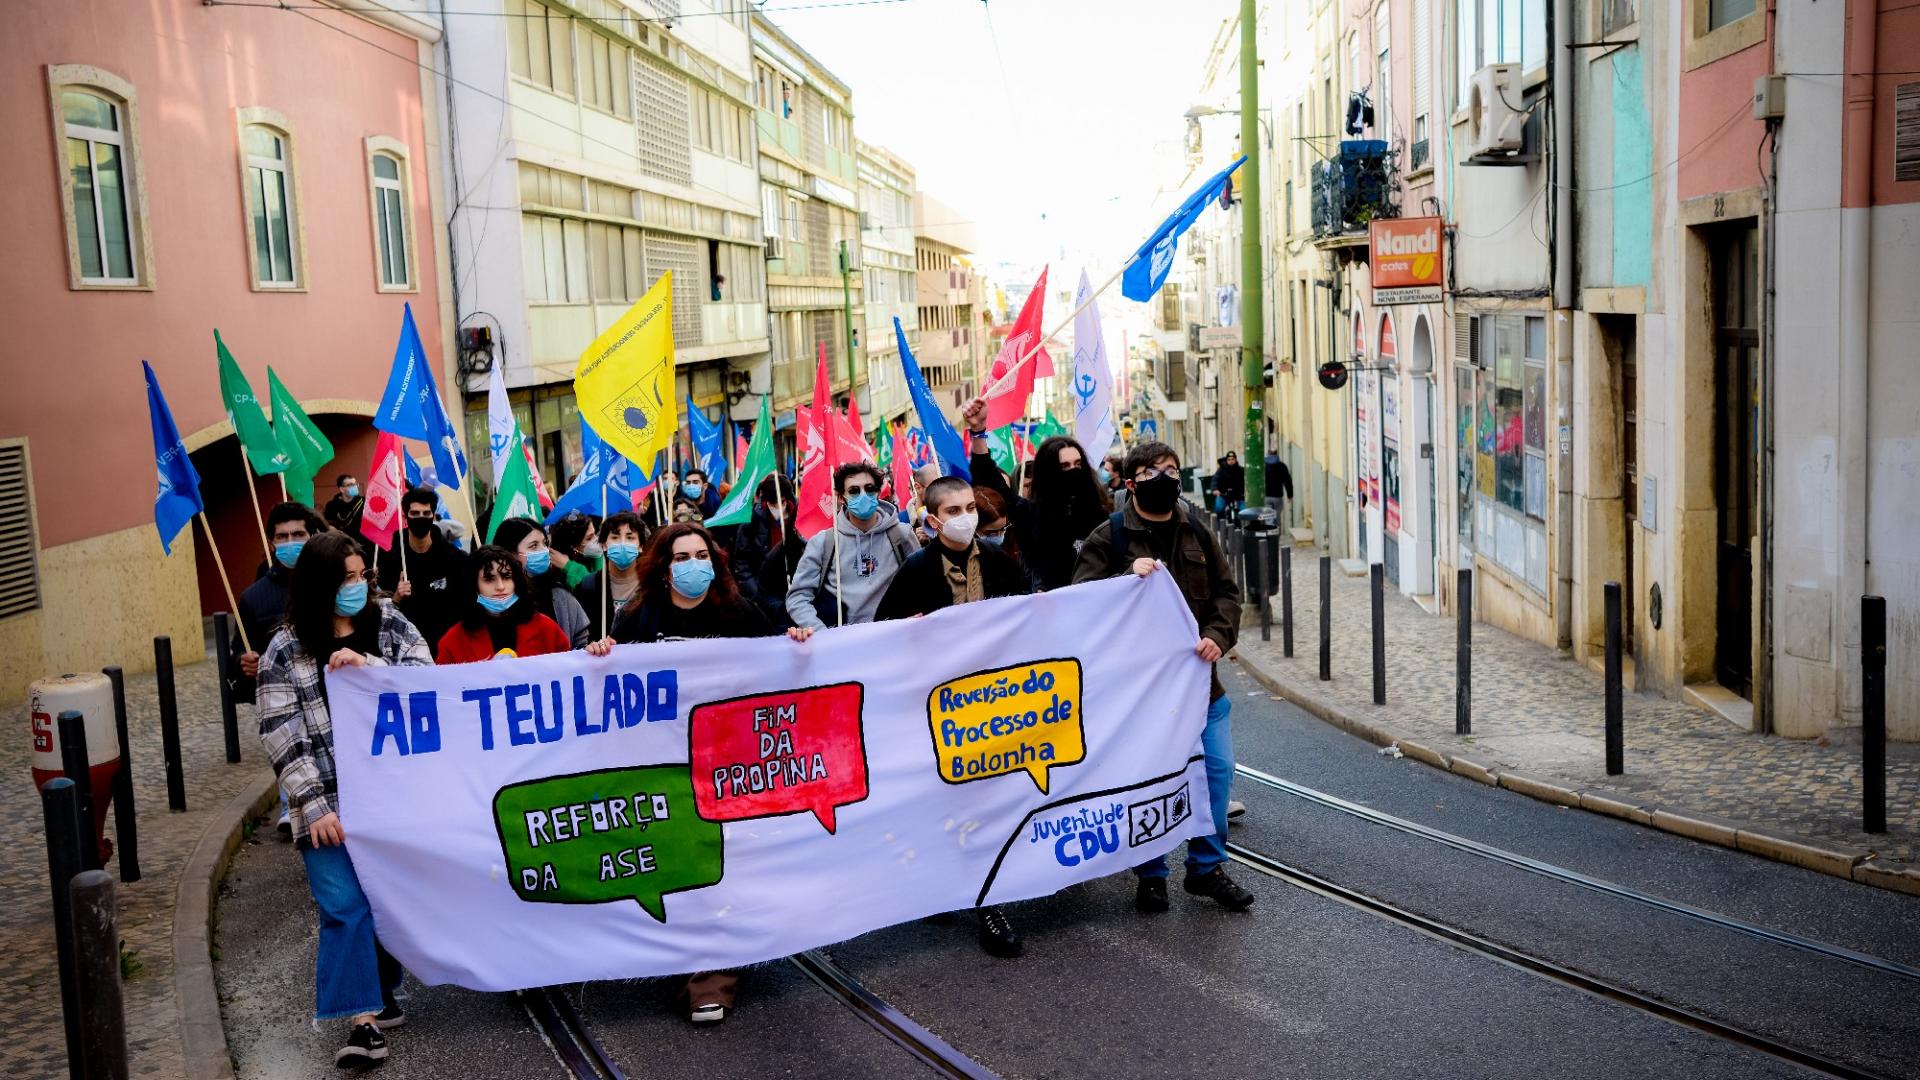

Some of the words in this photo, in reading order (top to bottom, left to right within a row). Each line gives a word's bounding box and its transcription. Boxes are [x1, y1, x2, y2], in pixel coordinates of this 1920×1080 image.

[1399, 293, 1440, 302] ESPERANÇA
[371, 691, 441, 756] AO
[462, 680, 563, 750] TEU
[573, 670, 677, 736] LADO
[939, 677, 1020, 713] Reversão
[1022, 669, 1055, 694] do
[941, 710, 1038, 747] Processo
[1042, 693, 1072, 724] de
[760, 730, 793, 759] DA
[952, 742, 1056, 777] Bolonha
[524, 792, 670, 848] REFORÇO
[1054, 823, 1120, 867] CDU
[520, 862, 559, 891] DA
[600, 844, 656, 881] ASE
